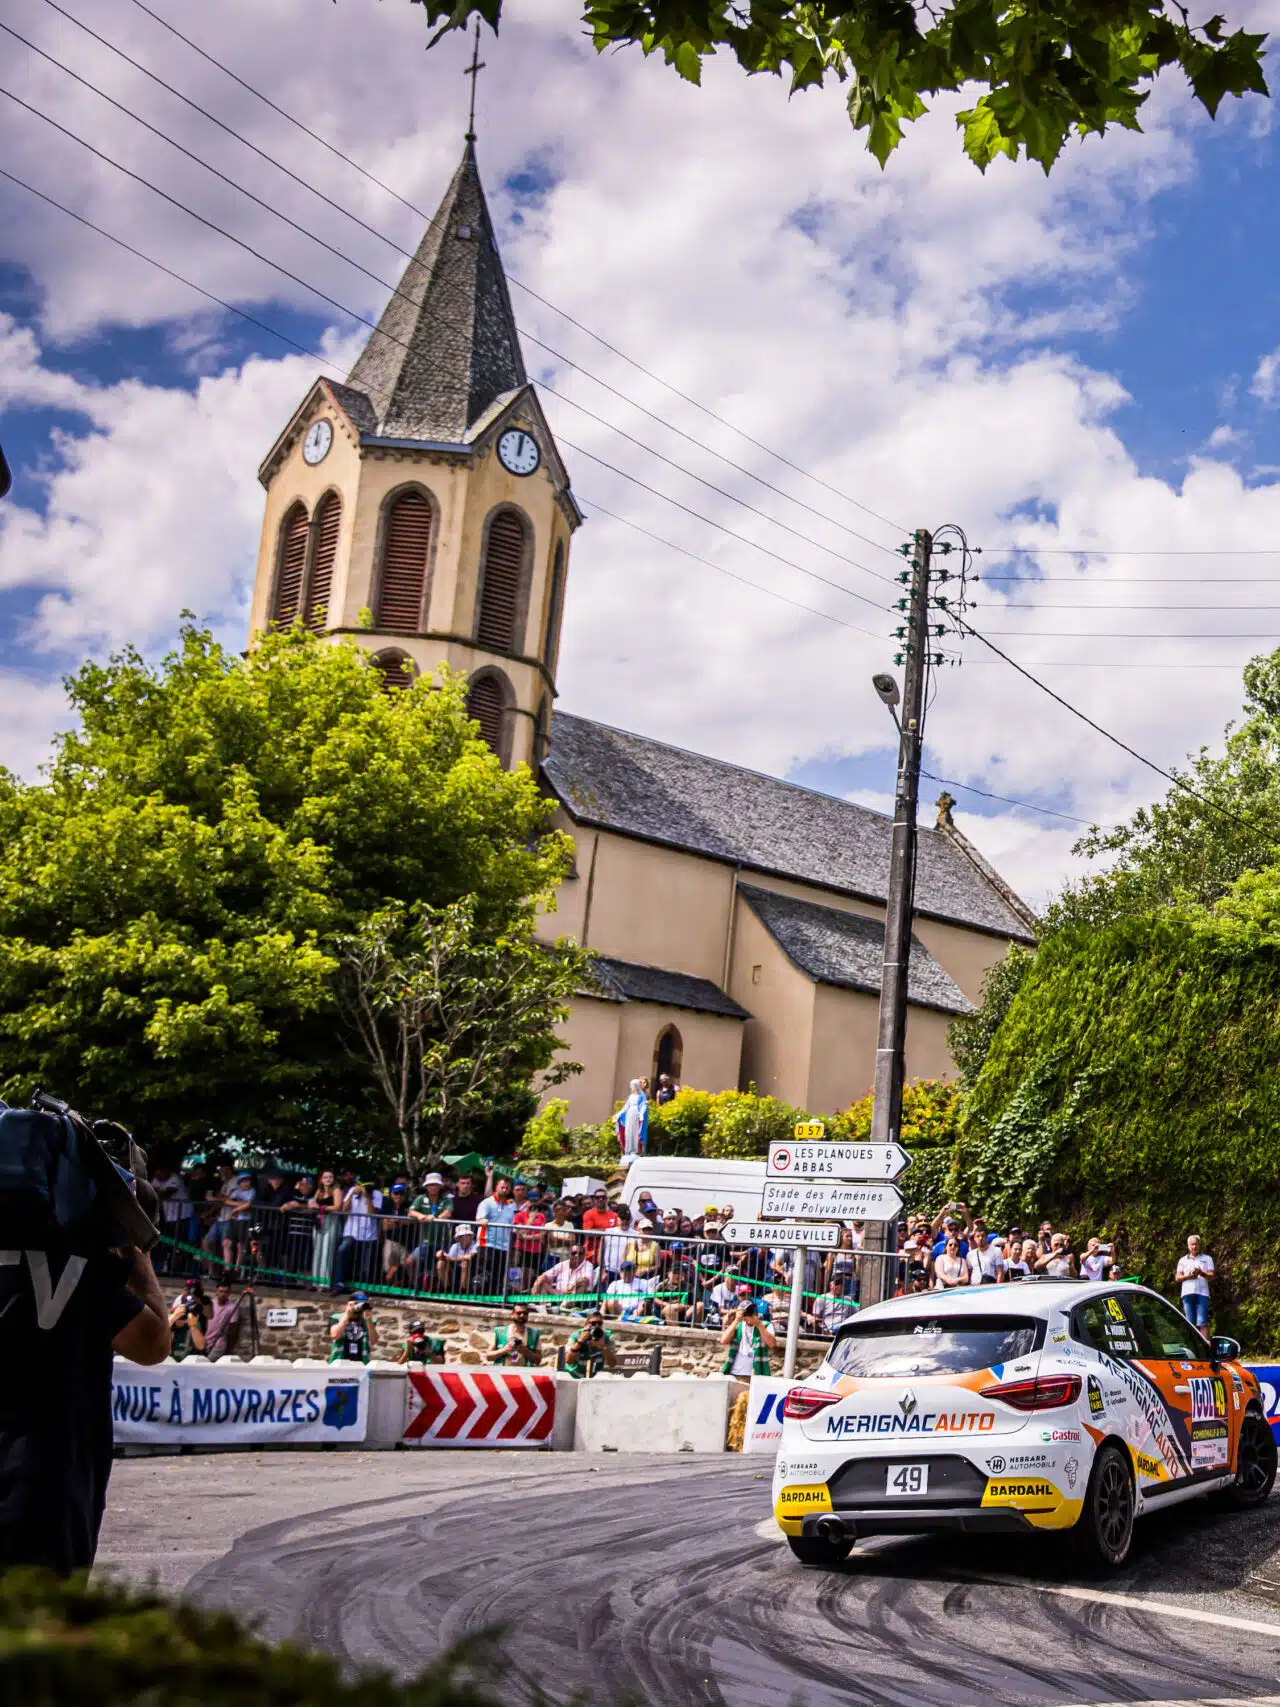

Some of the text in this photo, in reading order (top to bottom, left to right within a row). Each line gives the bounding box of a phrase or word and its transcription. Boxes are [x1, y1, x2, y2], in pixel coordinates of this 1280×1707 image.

[797, 1126, 821, 1135] D 57
[794, 1148, 892, 1160] LES PLANQUES 6
[794, 1162, 891, 1174] ABBAS 7
[768, 1188, 884, 1202] Stade des Arménies
[766, 1202, 867, 1215] Salle Polyvalente
[730, 1228, 834, 1241] 9 BARAQUEVILLE
[1108, 1299, 1124, 1321] 49
[624, 1356, 651, 1366] mairie
[167, 1380, 184, 1424] À
[192, 1388, 320, 1424] MOYRAZES
[1190, 1378, 1226, 1419] IGOL 49
[1052, 1430, 1080, 1441] Castrol
[1009, 1455, 1046, 1463] HEBRARD
[1009, 1461, 1057, 1470] AUTOMOBILE
[893, 1466, 922, 1493] 49
[990, 1484, 1053, 1496] BARDAHL
[781, 1491, 827, 1503] BARDAHL
